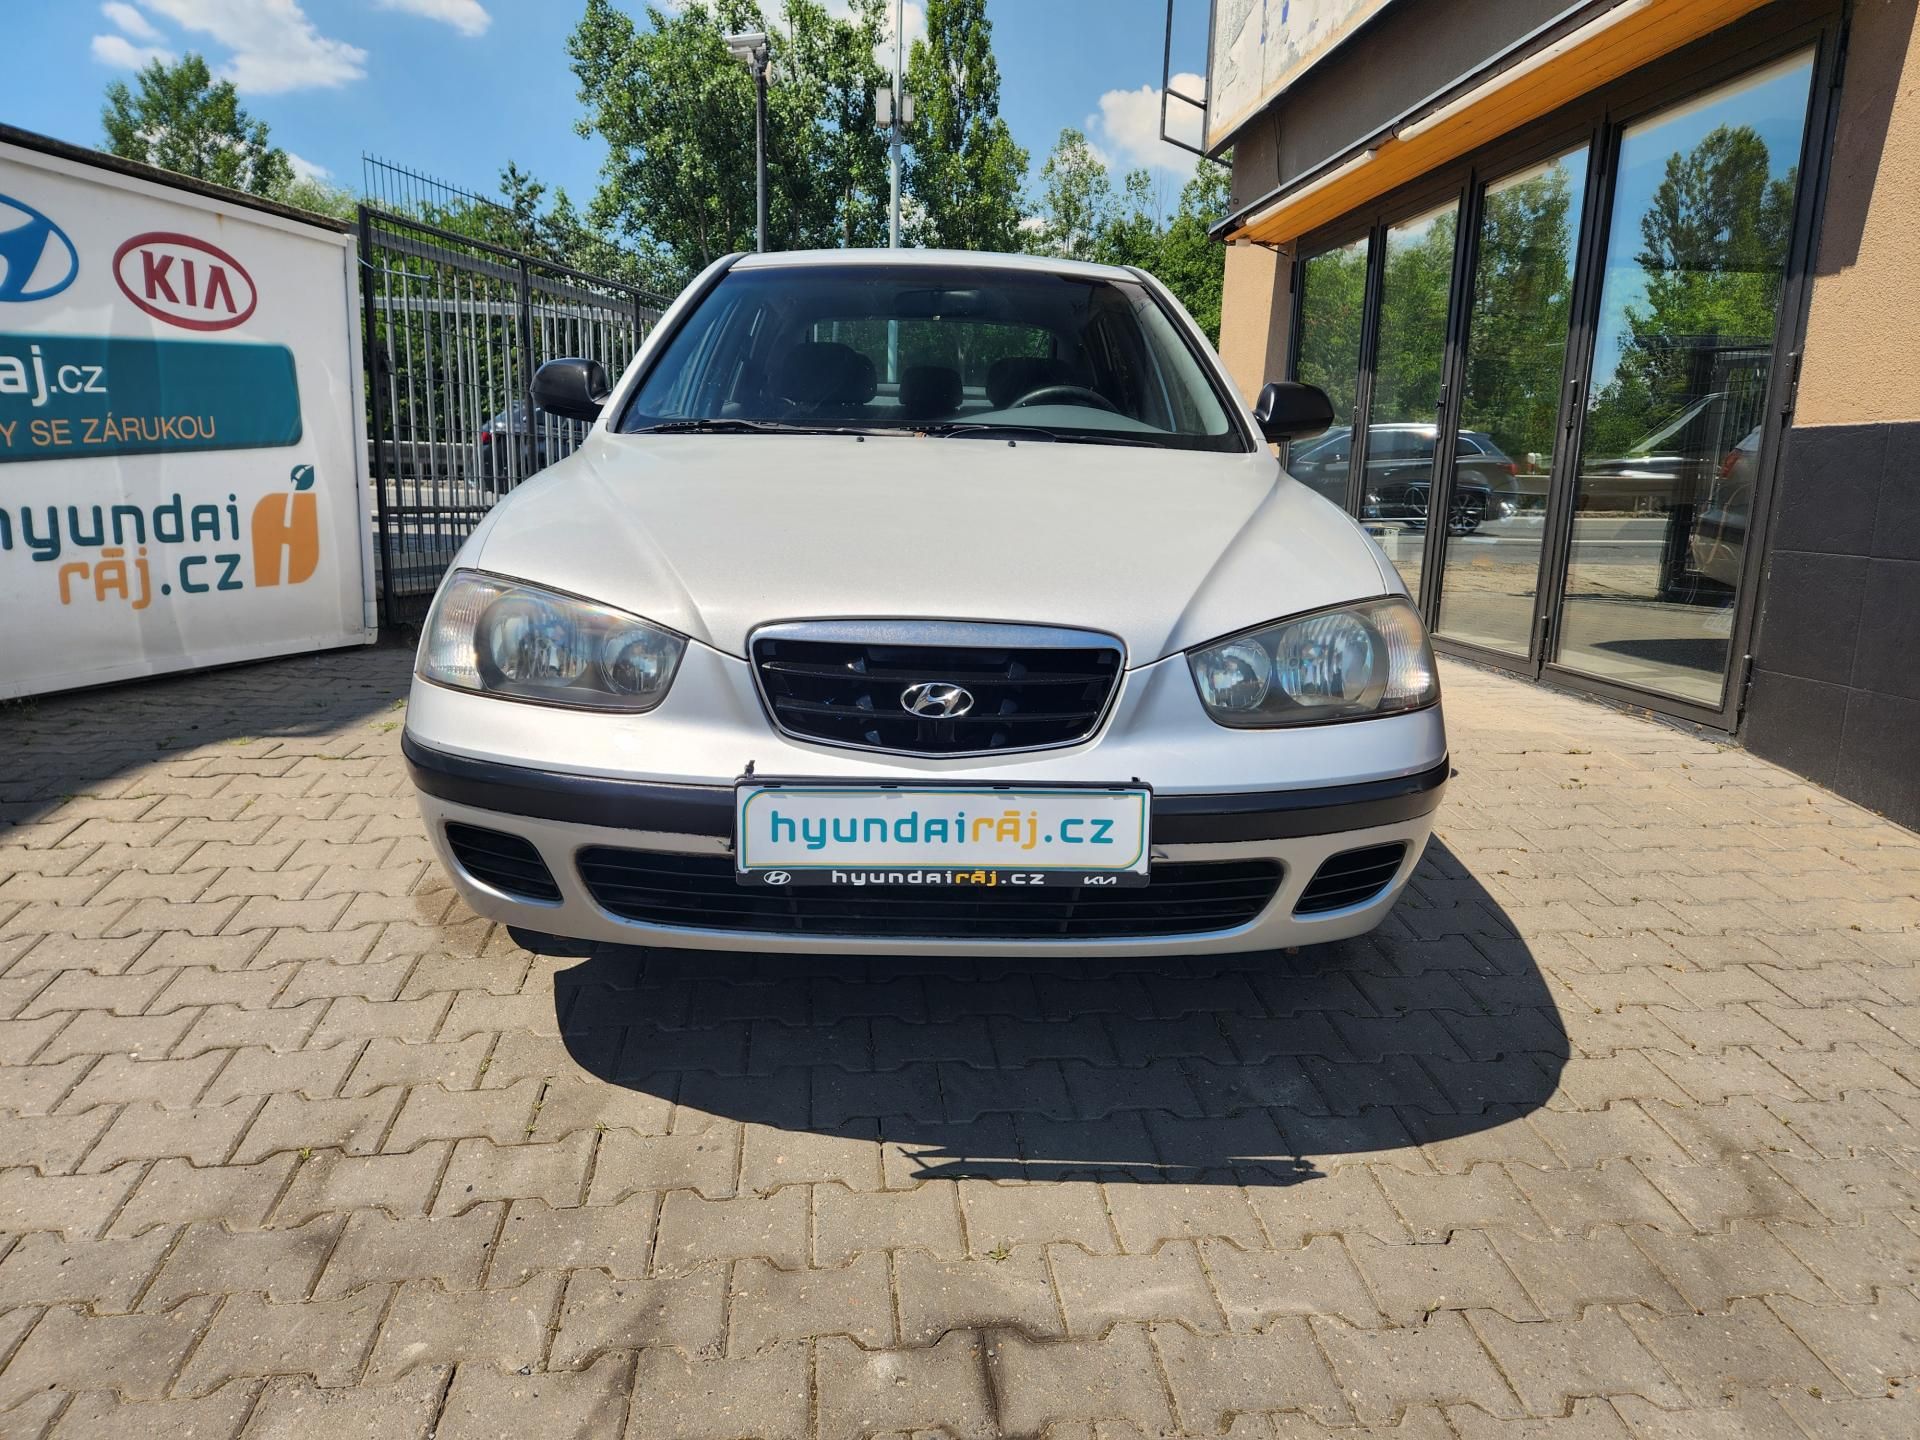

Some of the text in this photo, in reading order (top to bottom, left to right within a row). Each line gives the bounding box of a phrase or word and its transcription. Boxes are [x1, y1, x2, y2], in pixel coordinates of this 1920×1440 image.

[139, 249, 238, 315] KIA
[30, 419, 73, 446] SE
[80, 411, 217, 444] ZÁRUKOU
